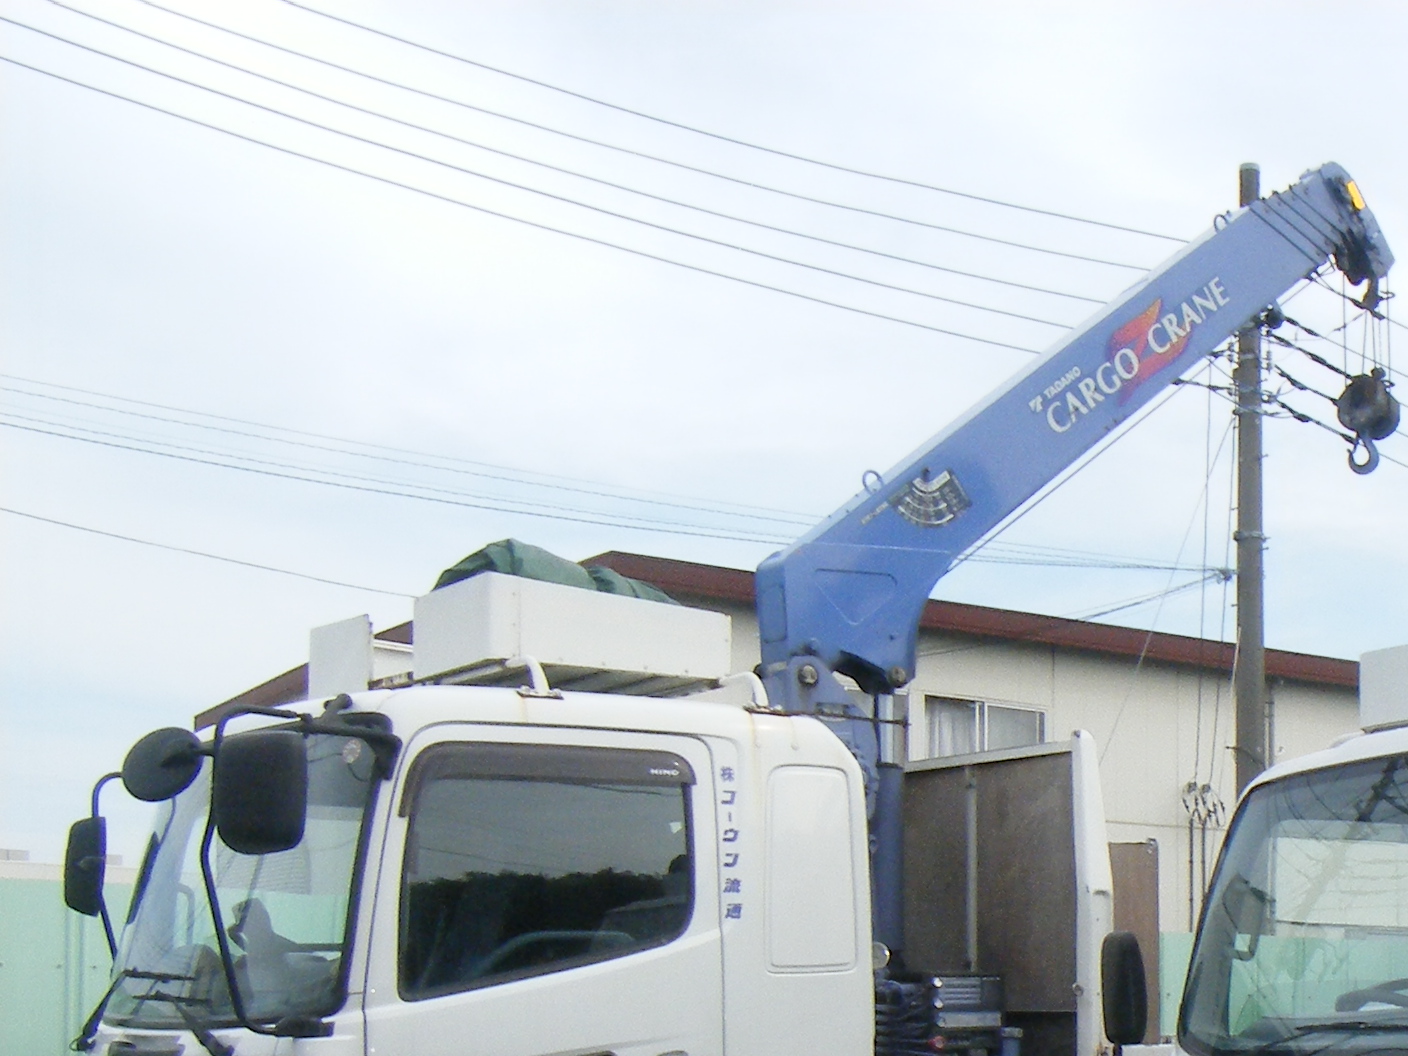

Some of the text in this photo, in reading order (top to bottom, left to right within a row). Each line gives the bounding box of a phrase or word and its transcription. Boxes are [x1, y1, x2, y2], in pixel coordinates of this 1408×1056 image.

[1044, 366, 1081, 399] TADANO
[1047, 276, 1231, 433] CARGO CRANE
